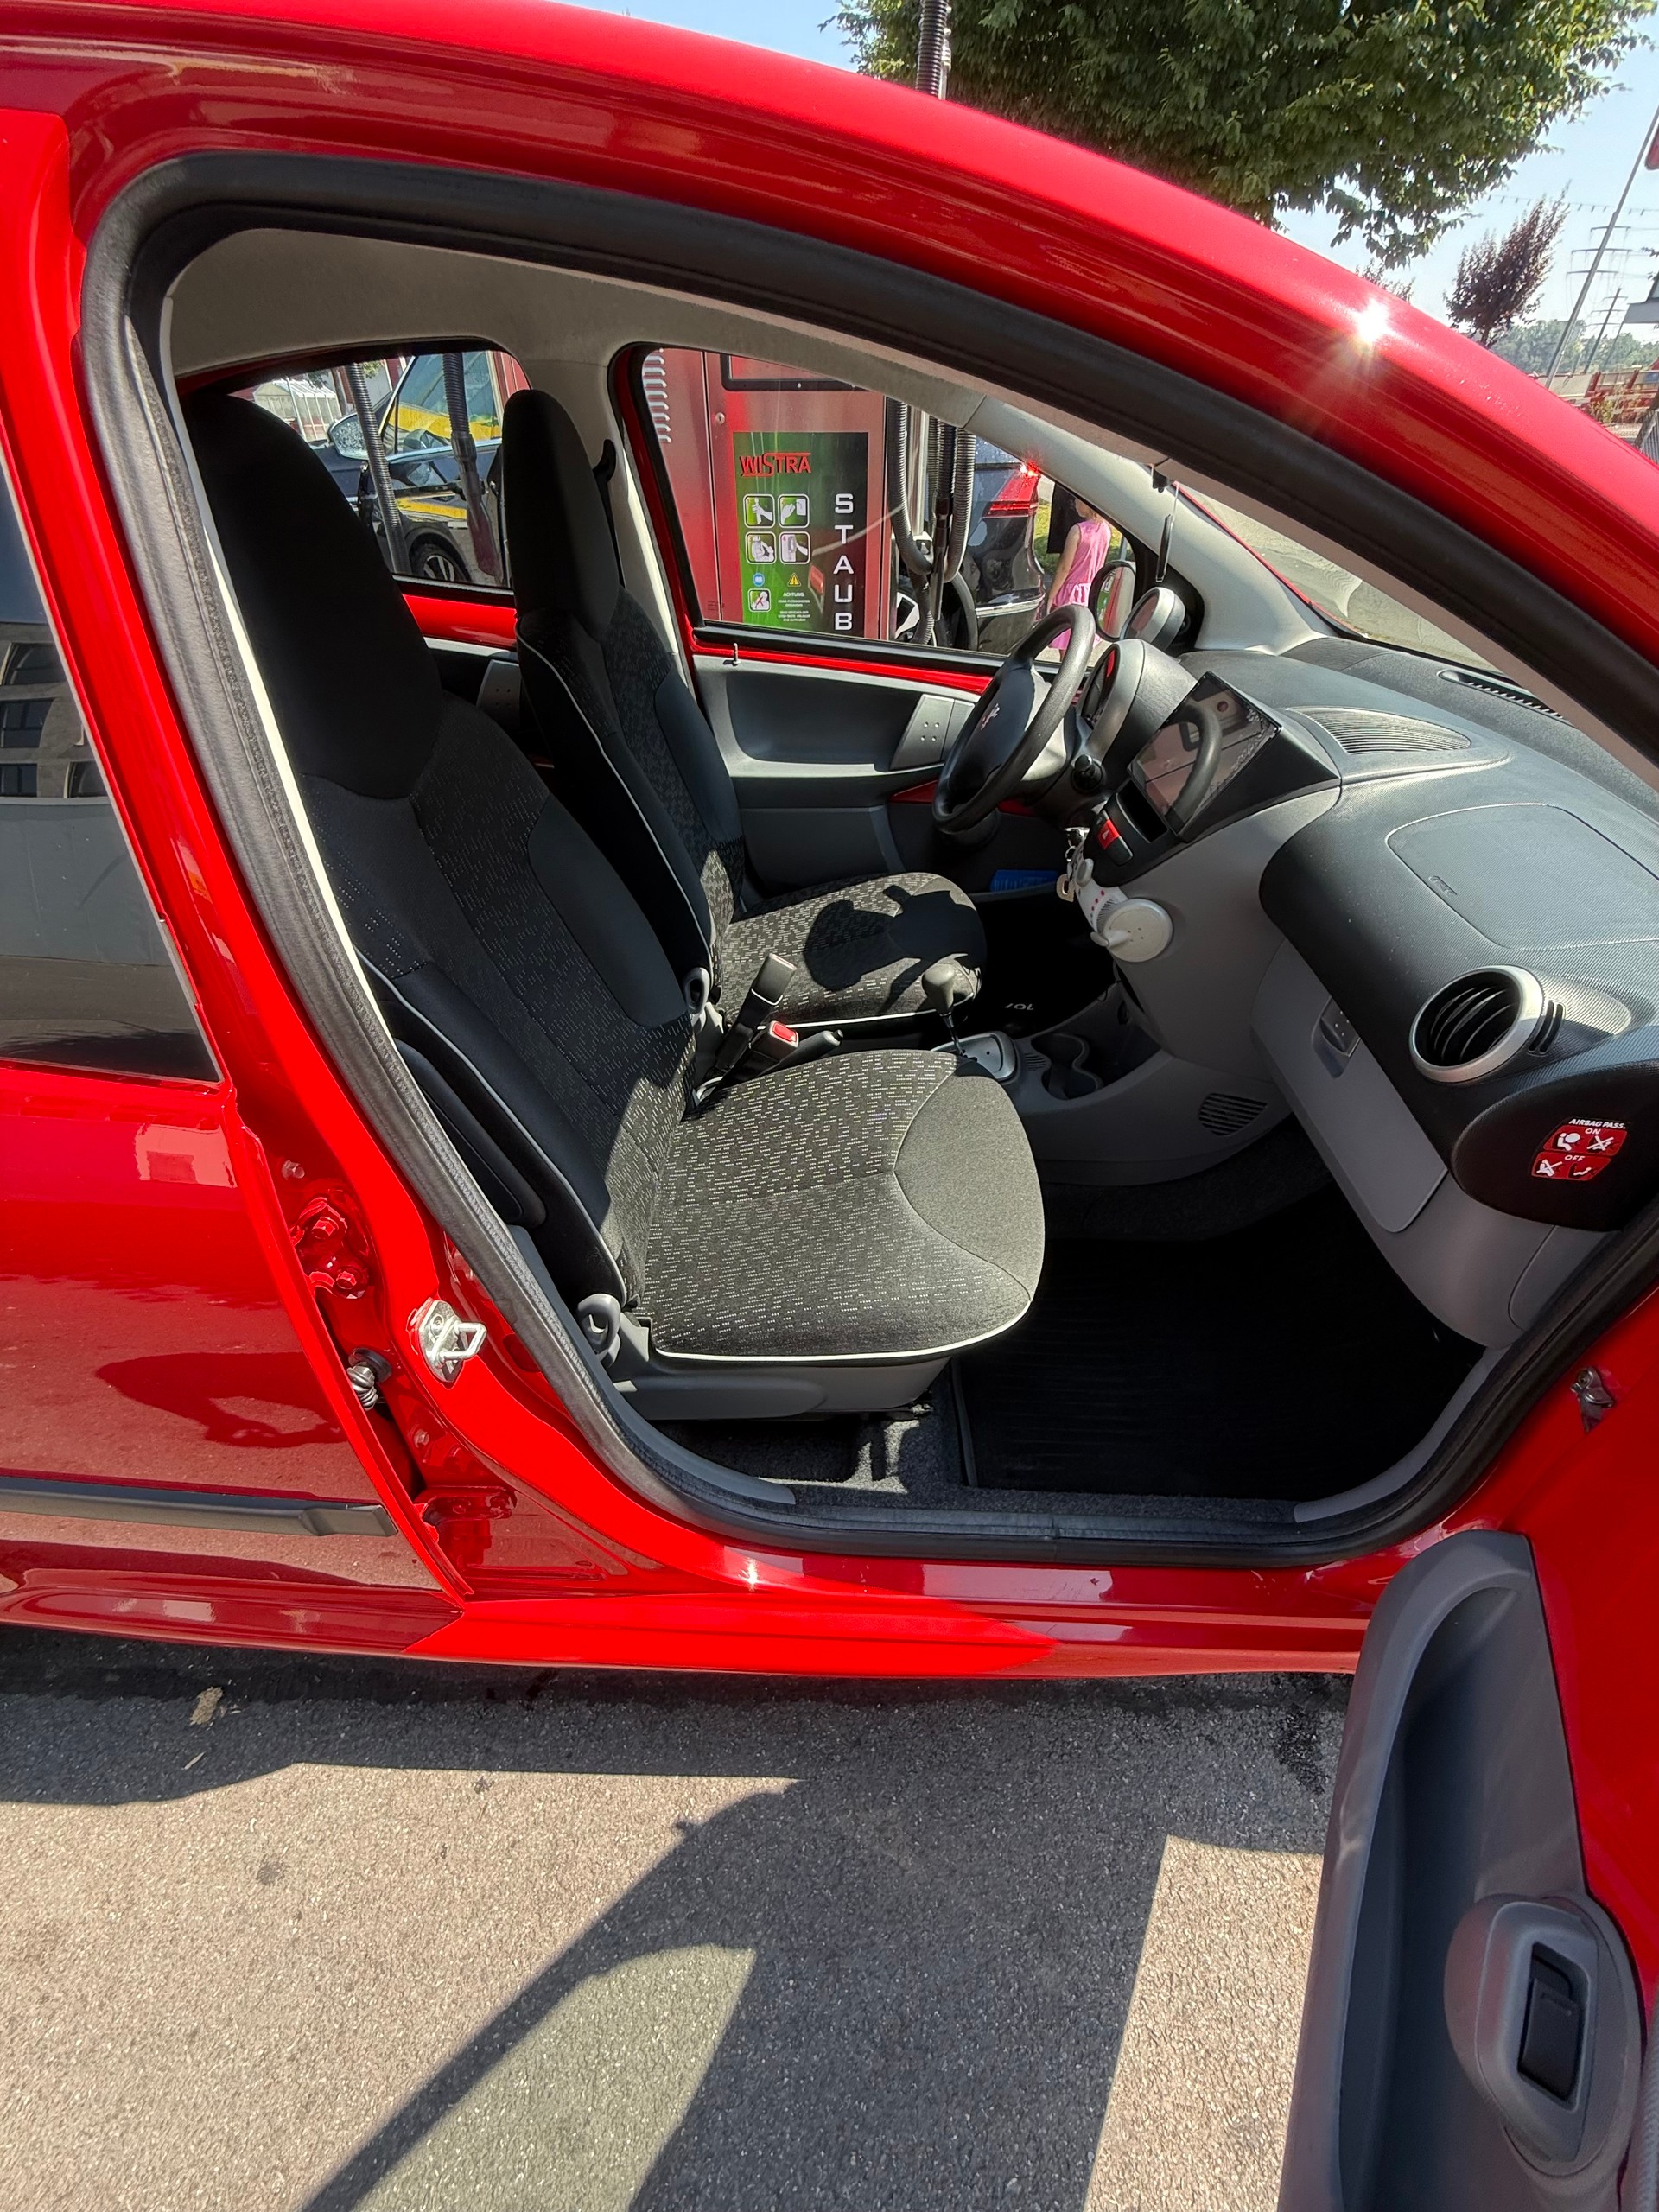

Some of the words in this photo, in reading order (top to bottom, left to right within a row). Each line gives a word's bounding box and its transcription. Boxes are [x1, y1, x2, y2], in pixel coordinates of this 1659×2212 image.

[739, 452, 811, 477] WISTRA
[833, 493, 854, 630] STAUB
[1568, 1118, 1603, 1127] AIRBAG
